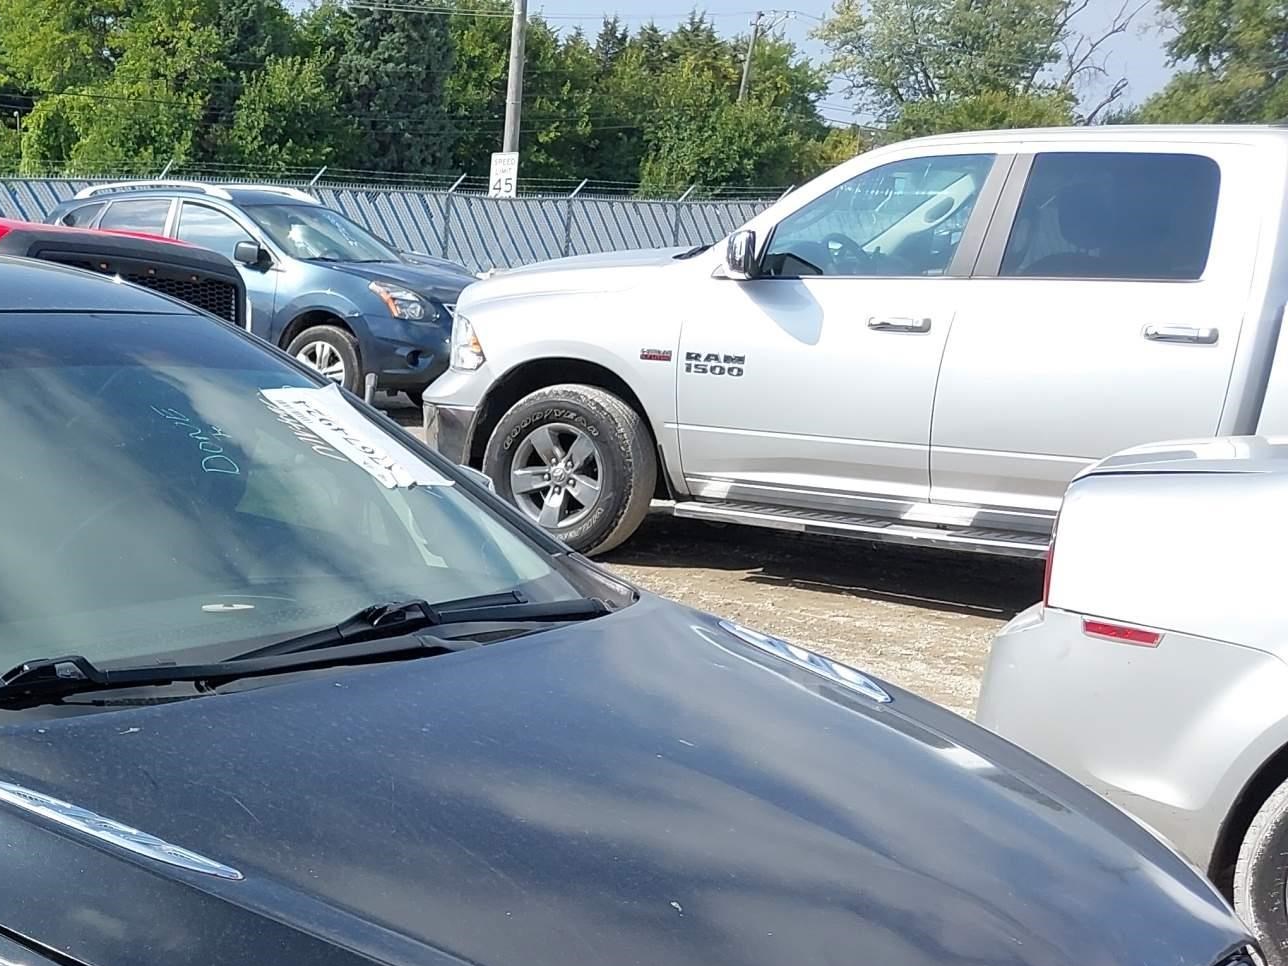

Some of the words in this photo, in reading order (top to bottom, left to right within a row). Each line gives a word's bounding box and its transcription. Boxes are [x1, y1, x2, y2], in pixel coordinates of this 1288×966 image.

[494, 158, 516, 166] SPEED
[495, 167, 513, 176] LIMIT
[492, 177, 514, 193] 45
[685, 351, 746, 365] RAM
[685, 363, 744, 377] 1500
